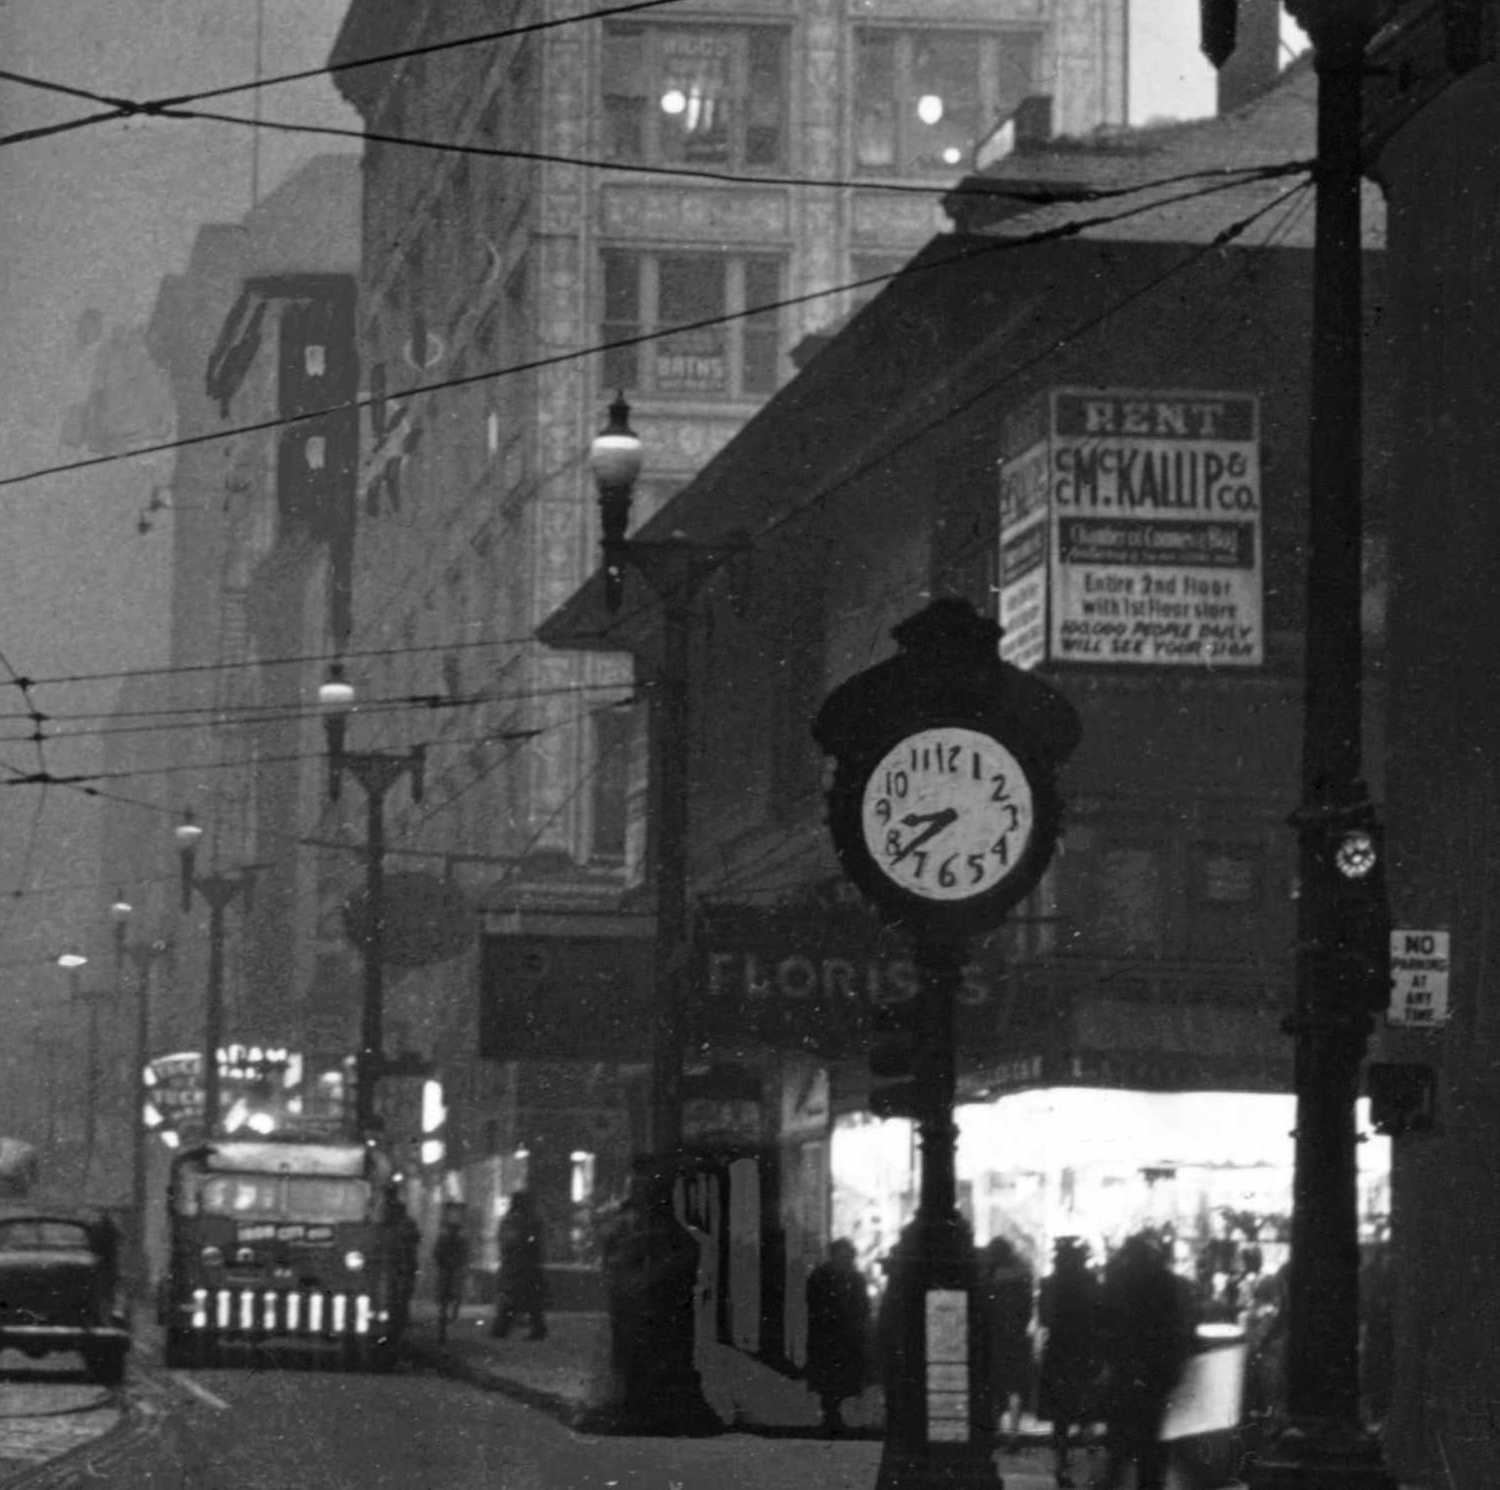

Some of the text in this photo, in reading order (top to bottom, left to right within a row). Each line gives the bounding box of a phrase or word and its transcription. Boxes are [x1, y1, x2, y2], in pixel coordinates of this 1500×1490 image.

[1084, 400, 1228, 438] RENT
[1141, 574, 1177, 593] 2nd
[1132, 620, 1192, 639] PEOPLE
[1199, 622, 1253, 641] DAILY
[1062, 636, 1253, 657] WILL SEE YOUR SIGN
[910, 747, 930, 772] 11
[935, 741, 963, 774] 12
[972, 751, 982, 780] 1
[885, 770, 909, 799] 10
[990, 773, 1011, 802] 2
[875, 798, 893, 826] 9
[1001, 803, 1020, 832] 3
[884, 828, 902, 857] 8
[990, 834, 1009, 866] 4
[912, 850, 930, 879] 7
[937, 852, 960, 888] 6
[965, 853, 986, 885] 5
[1404, 934, 1435, 956] NO
[708, 950, 989, 1005] FLORISS
[1411, 974, 1428, 988] AT
[1405, 991, 1432, 1005] ANY
[1404, 1008, 1435, 1022] TIME
